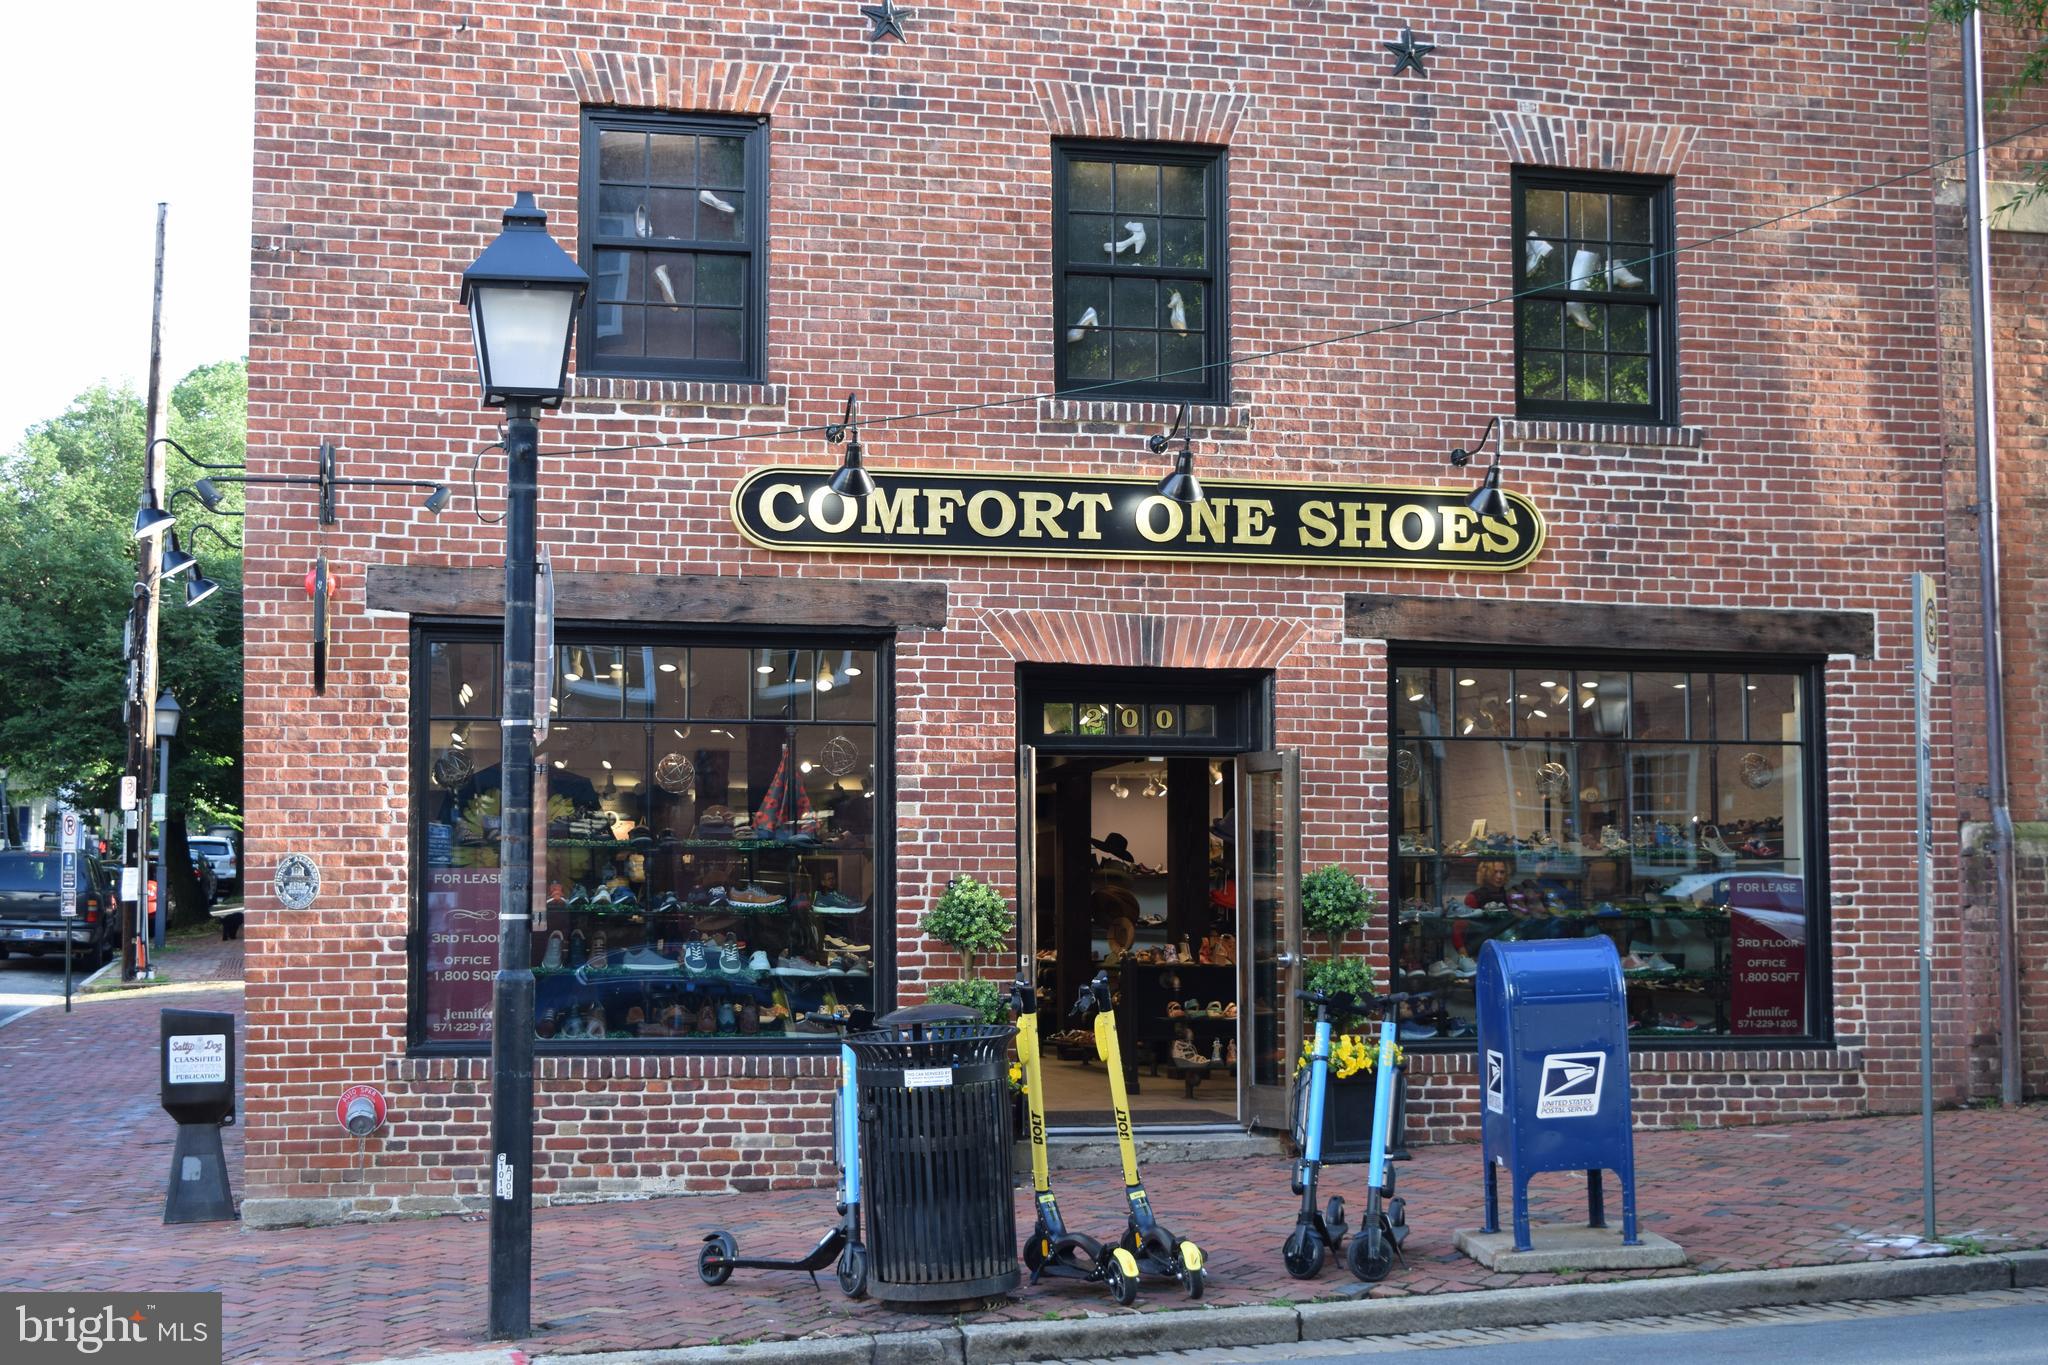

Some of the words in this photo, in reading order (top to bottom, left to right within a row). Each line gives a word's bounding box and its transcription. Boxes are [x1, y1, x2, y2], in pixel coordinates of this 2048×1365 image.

[758, 483, 1113, 540] COMFORT
[1134, 493, 1276, 545] ONE
[1298, 500, 1521, 553] SHOES
[434, 873, 461, 884] FOR
[1736, 882, 1760, 893] FOR
[1762, 883, 1797, 893] LEASE
[432, 932, 460, 943] 3RD
[1736, 938, 1760, 948] 3RD
[1763, 939, 1799, 948] FLOOR
[444, 956, 492, 965] OFFICE
[1747, 959, 1787, 968] OFFICE
[434, 970, 470, 982] 1,800
[472, 970, 498, 982] SQF
[1739, 972, 1769, 982] 1,800
[1771, 972, 1800, 983] SQFT
[1746, 1006, 1789, 1018] Jennifer
[433, 1022, 493, 1032] 571-229-12
[1737, 1019, 1798, 1028] 571-229-1205
[204, 1040, 224, 1053] Dog
[342, 1088, 357, 1103] AUTO
[1542, 1099, 1568, 1107] UNITED
[1031, 1110, 1043, 1145] BOLT
[1115, 1106, 1130, 1141] BOLT
